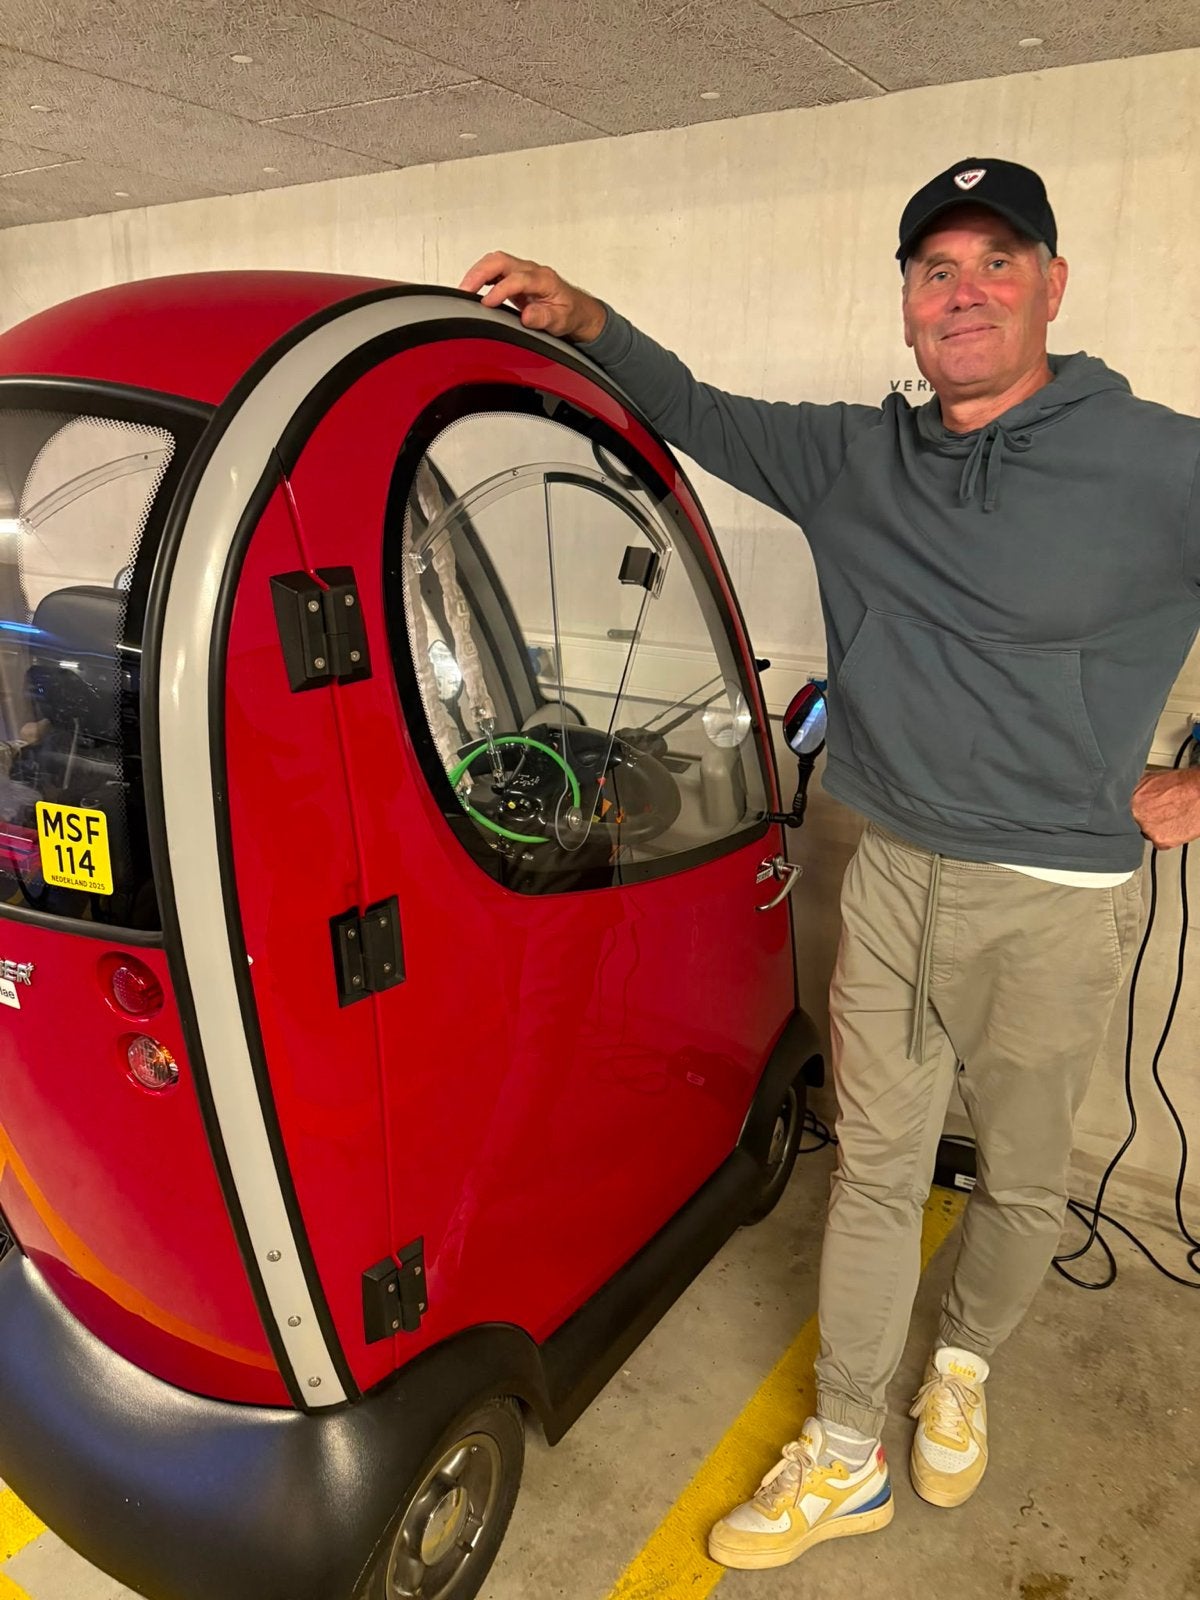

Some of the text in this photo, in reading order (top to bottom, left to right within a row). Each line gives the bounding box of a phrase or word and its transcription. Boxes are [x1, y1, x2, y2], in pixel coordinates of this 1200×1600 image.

[42, 808, 100, 845] MSF
[54, 844, 96, 878] 114
[51, 875, 106, 891] NEDERLAND 2025
